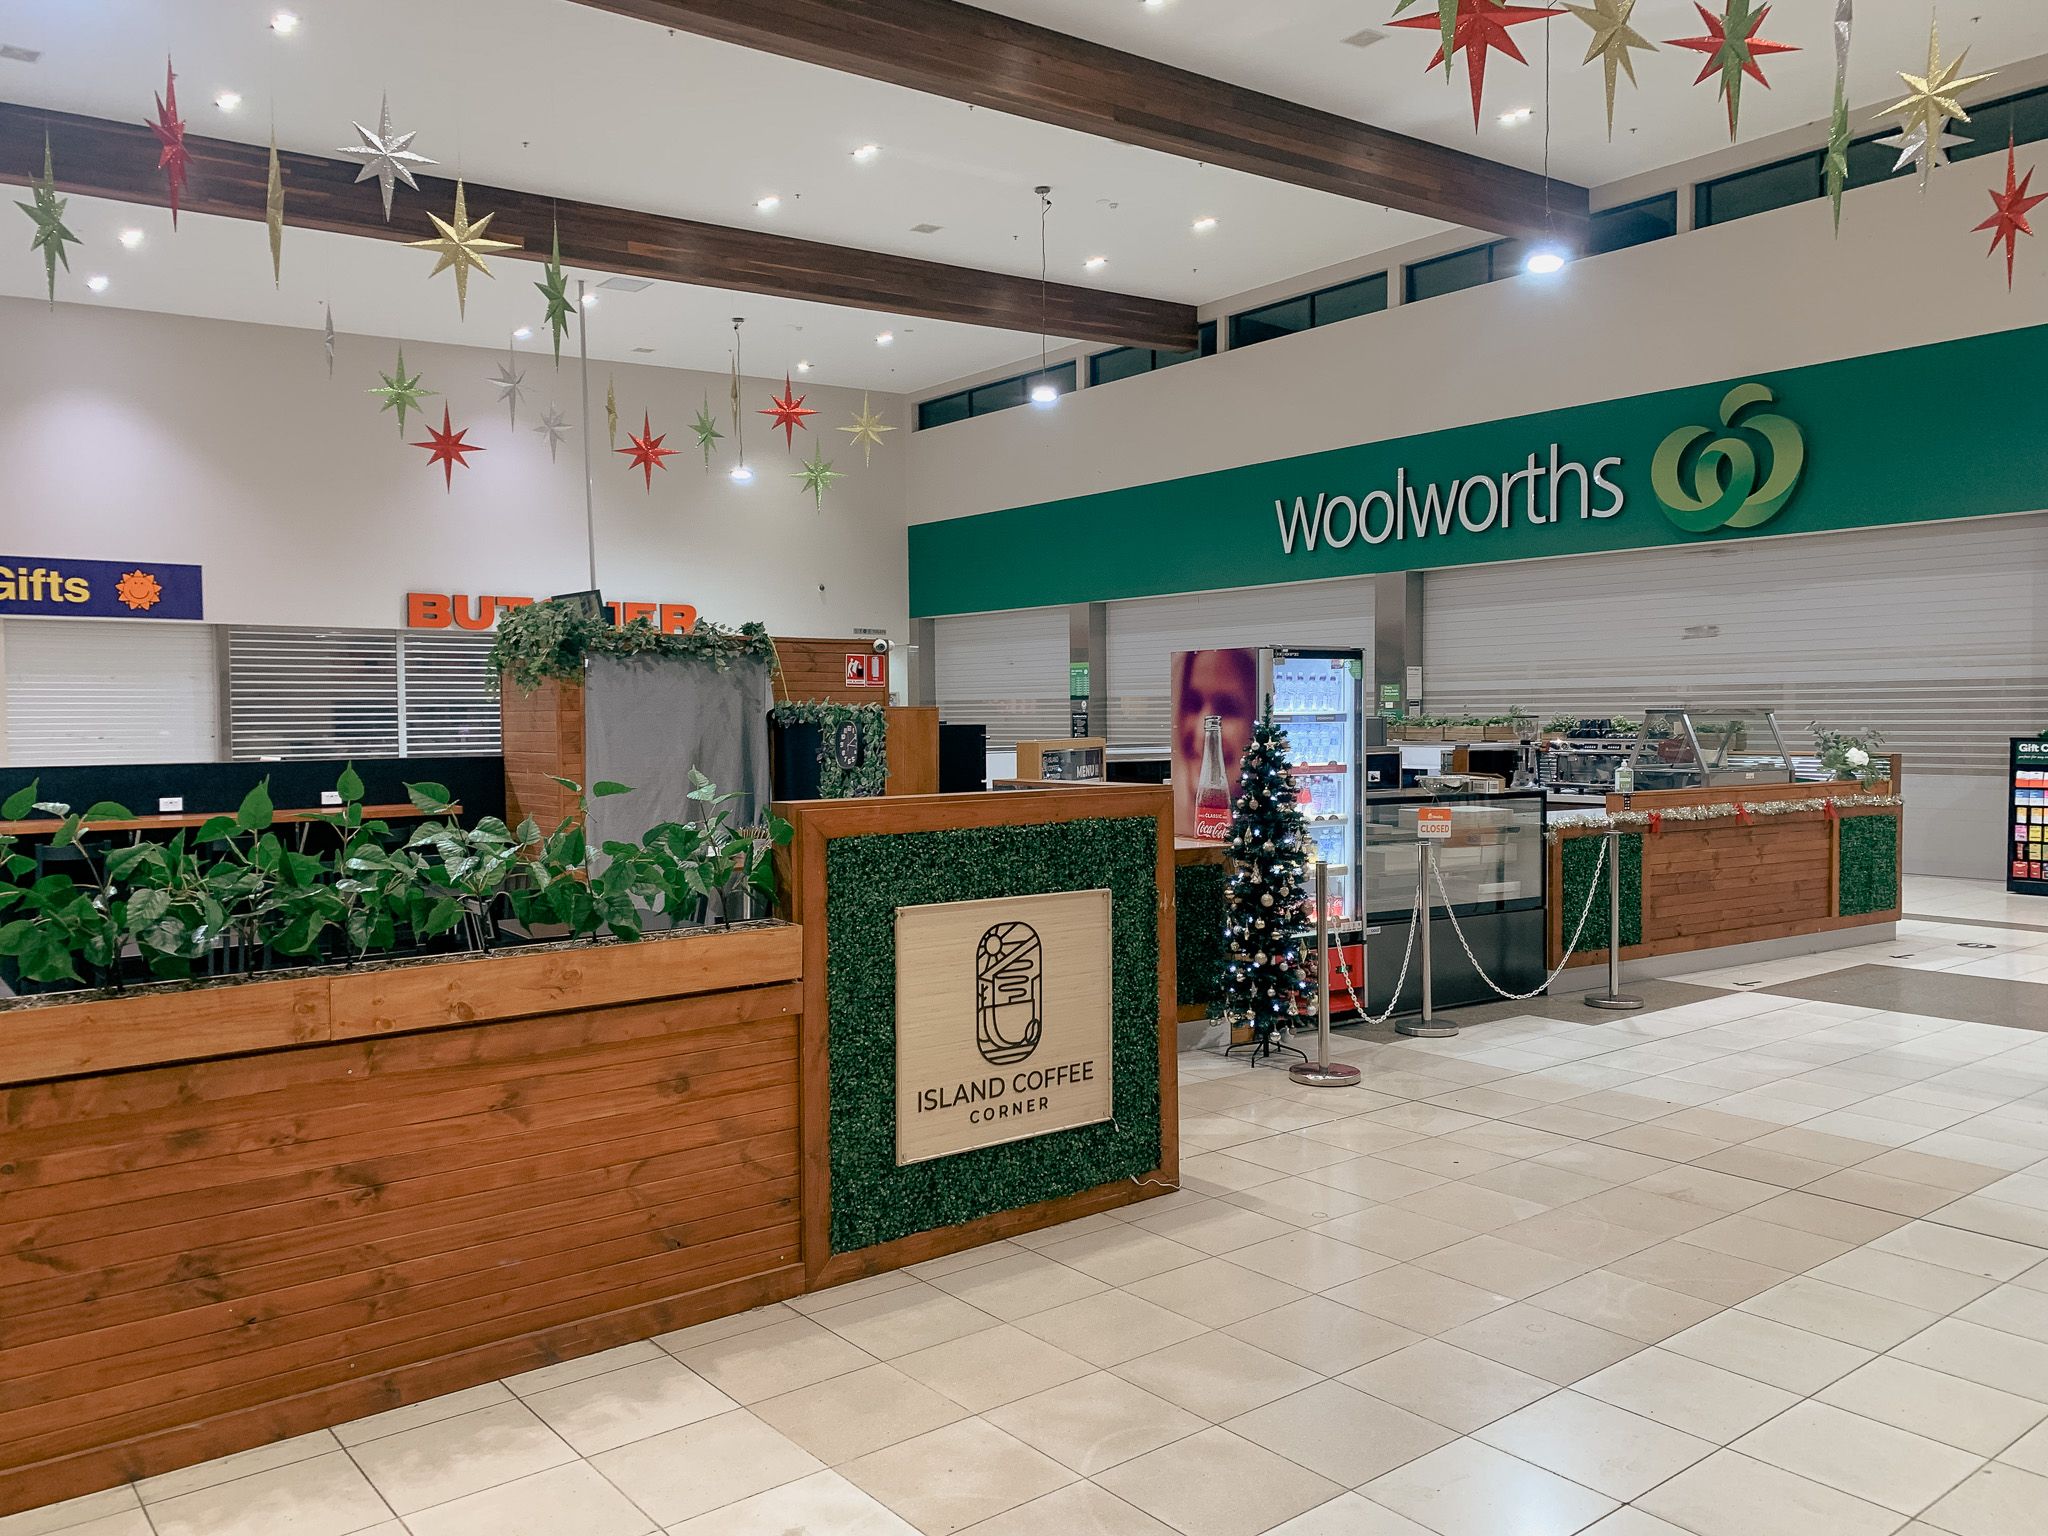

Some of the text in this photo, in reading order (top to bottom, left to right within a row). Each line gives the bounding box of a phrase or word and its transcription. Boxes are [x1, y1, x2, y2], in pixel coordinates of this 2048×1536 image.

[1275, 443, 1624, 555] Woolworths
[1077, 764, 1095, 778] MENU
[917, 1061, 1095, 1113] ISLAND COFFEE
[969, 1096, 1050, 1124] CORNER
